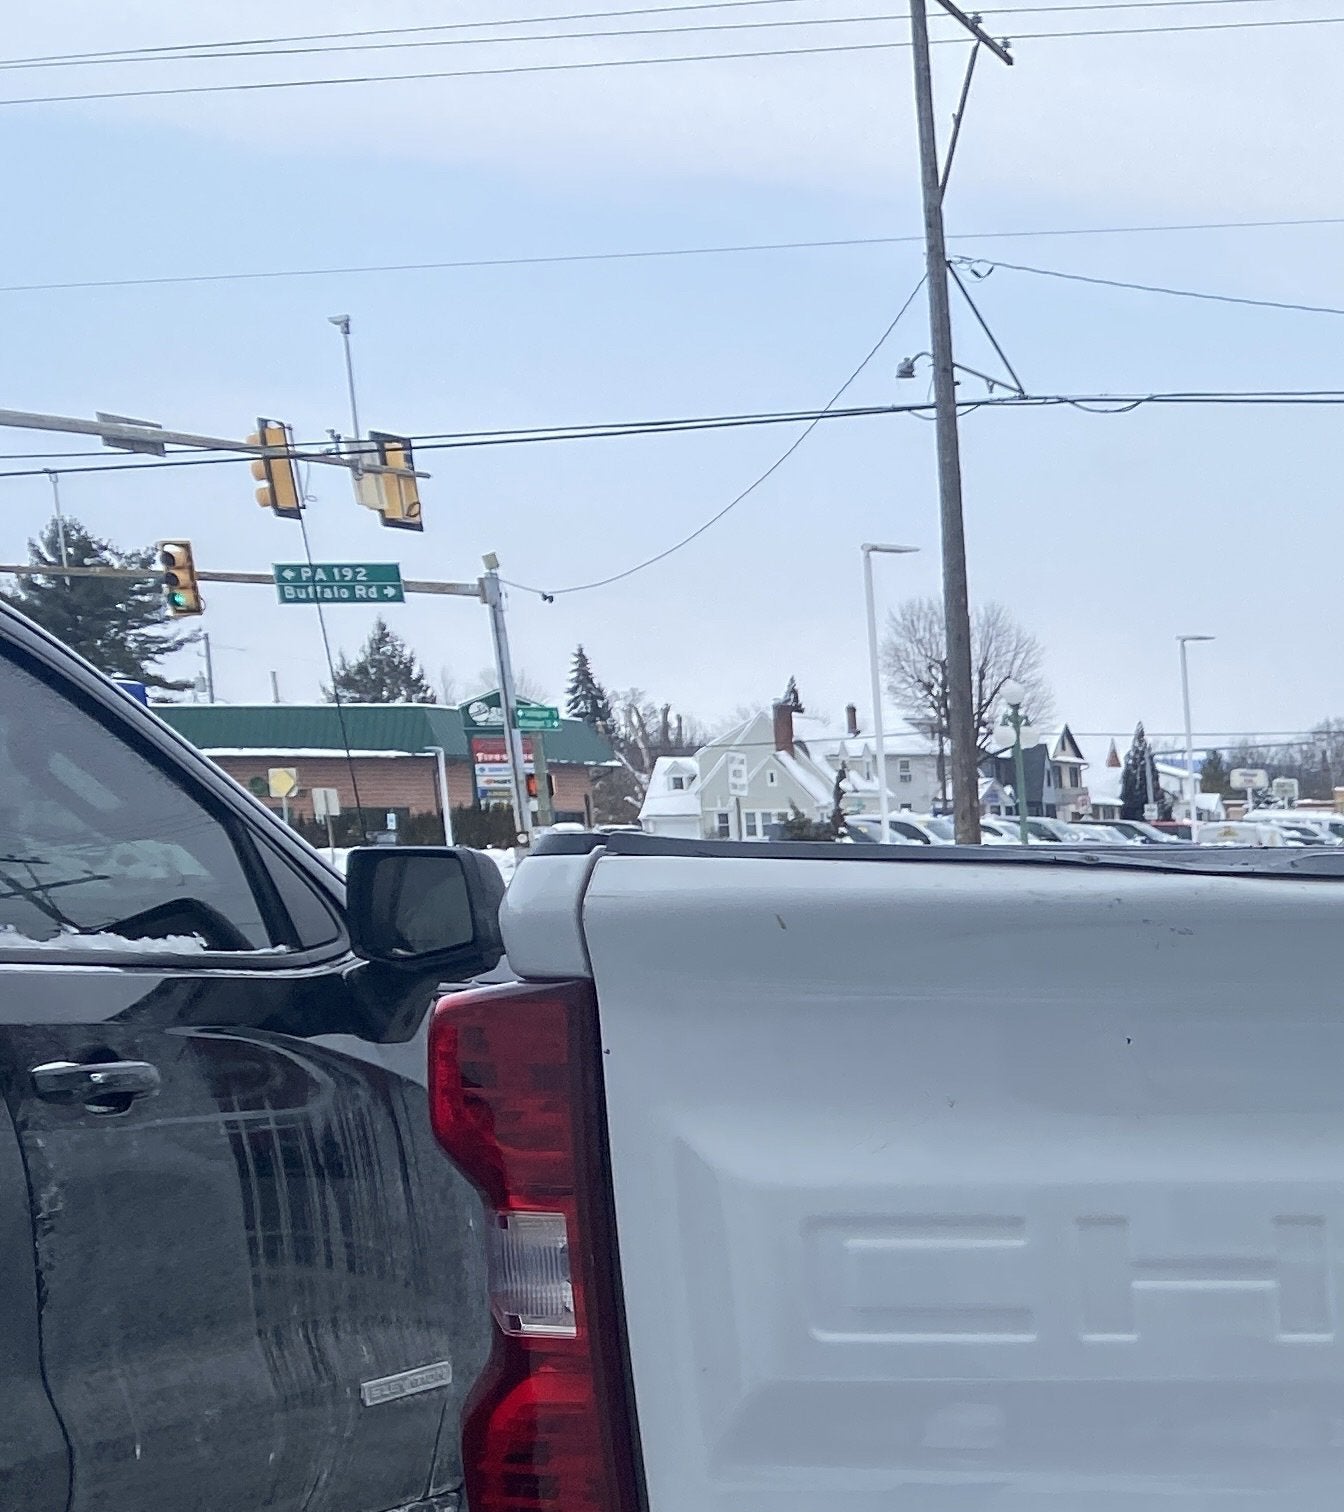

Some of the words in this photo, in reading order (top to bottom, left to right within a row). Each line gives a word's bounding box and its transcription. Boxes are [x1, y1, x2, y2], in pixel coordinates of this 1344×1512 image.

[300, 567, 327, 581] PA
[333, 567, 368, 581] 192
[284, 585, 349, 599] Buffalo
[355, 585, 377, 599] Rd
